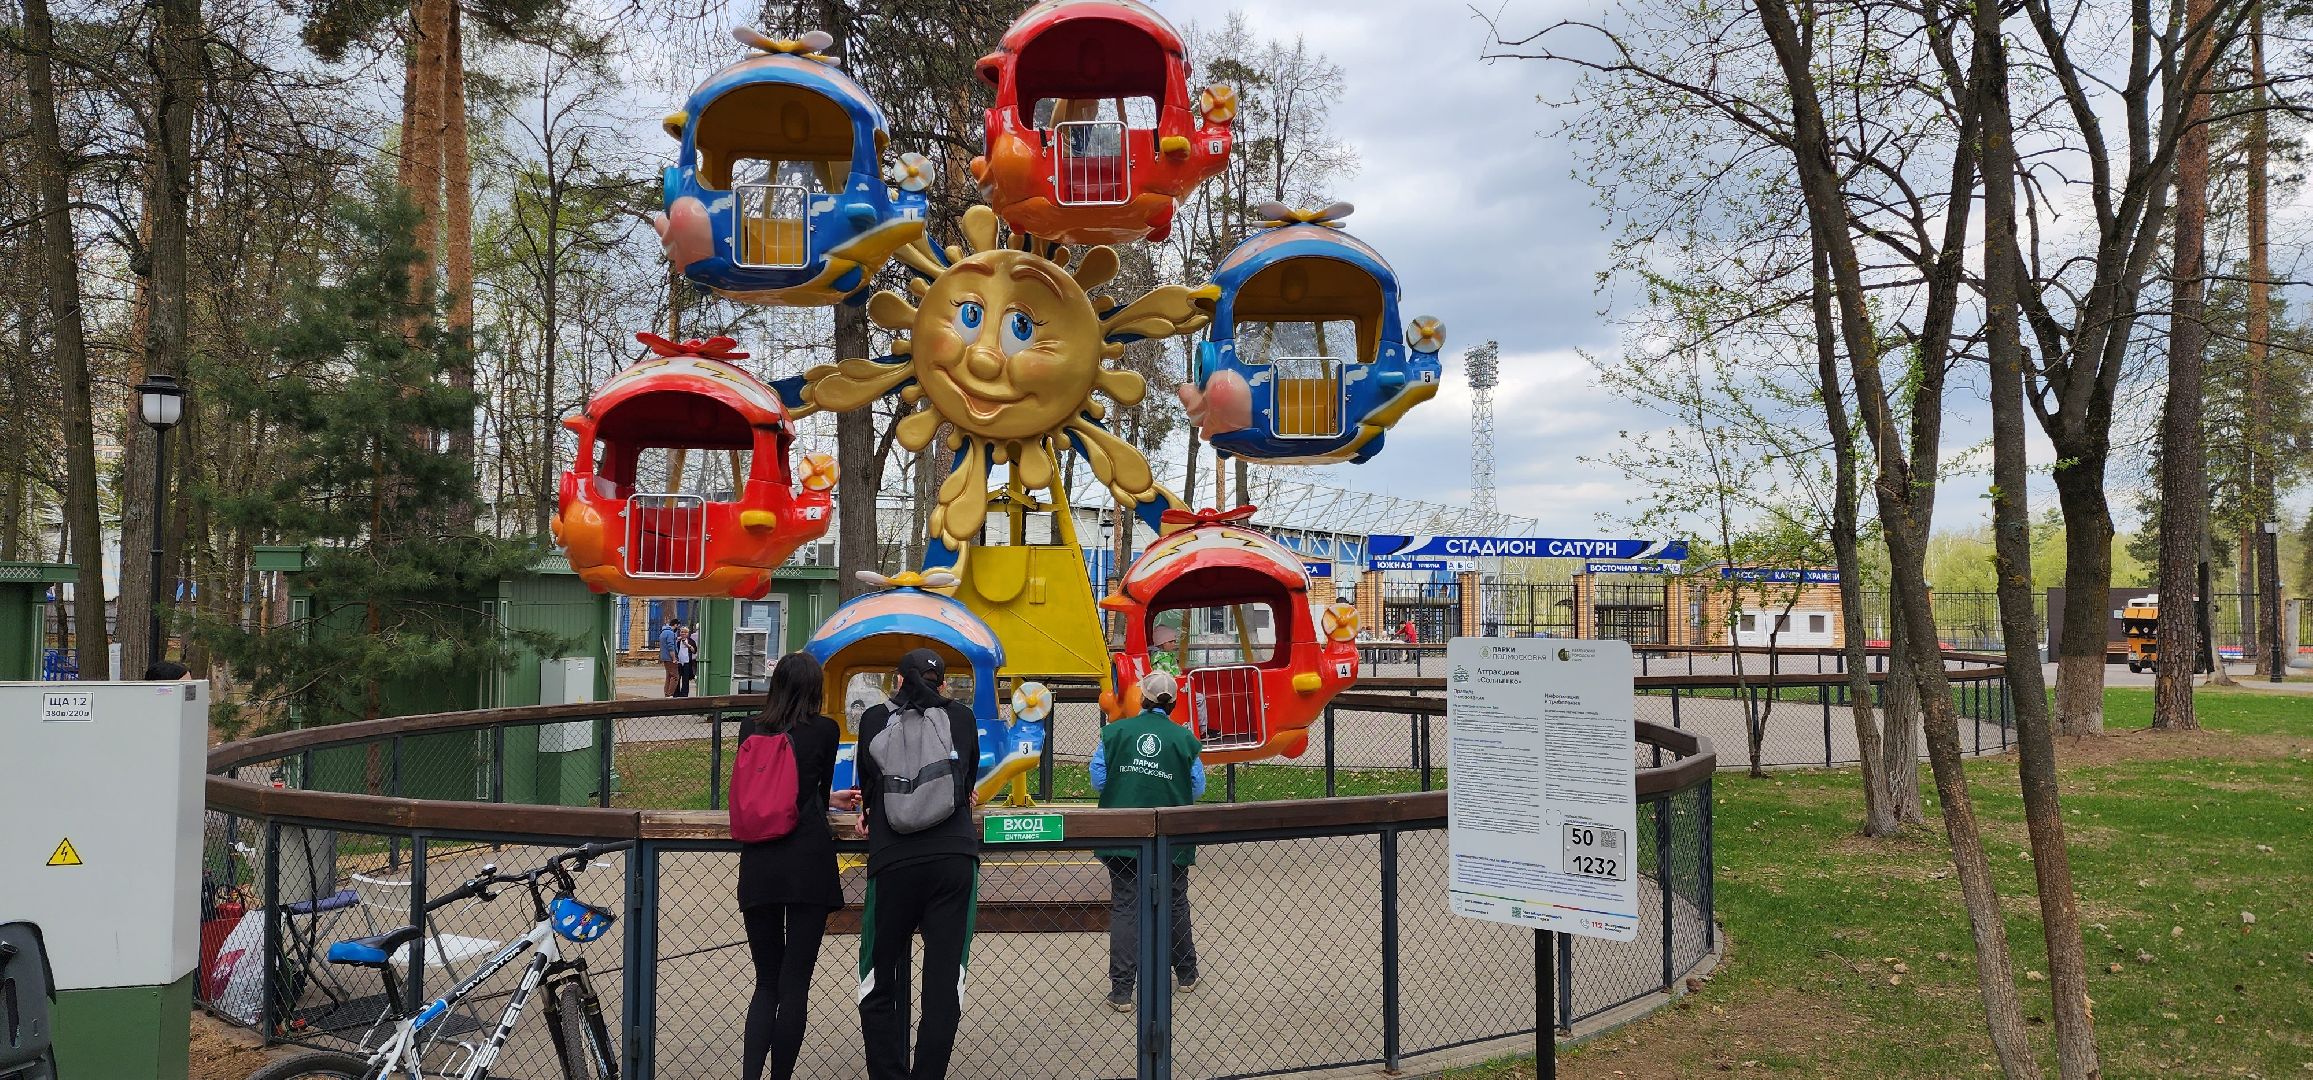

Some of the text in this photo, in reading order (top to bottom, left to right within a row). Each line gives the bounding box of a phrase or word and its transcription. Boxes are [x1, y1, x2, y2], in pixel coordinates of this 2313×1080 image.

[1212, 141, 1219, 153] 6
[1424, 371, 1431, 383] 5
[810, 507, 817, 519] 2
[1445, 539, 1617, 556] СТАДИОН САТУРН
[1377, 561, 1413, 569] ЮЖНАЯ
[1590, 564, 1638, 572] ВОСТОЧНАЯ
[1340, 664, 1348, 677] 4
[1477, 667, 1520, 677] Аттракцион
[49, 697, 87, 708] ЩА 1.2
[1022, 742, 1029, 755] 3
[1133, 758, 1159, 770] ПАРКИ
[1119, 765, 1173, 780] ПОДМОСКОВЬЯ
[1003, 818, 1043, 832] ВХОД
[1005, 833, 1040, 841] ENTRANCE
[1572, 828, 1594, 846] 50
[1572, 855, 1617, 877] 1232
[1591, 921, 1603, 929] 112
[456, 947, 521, 998] NAVIGATOR
[479, 967, 542, 1071] STELS
